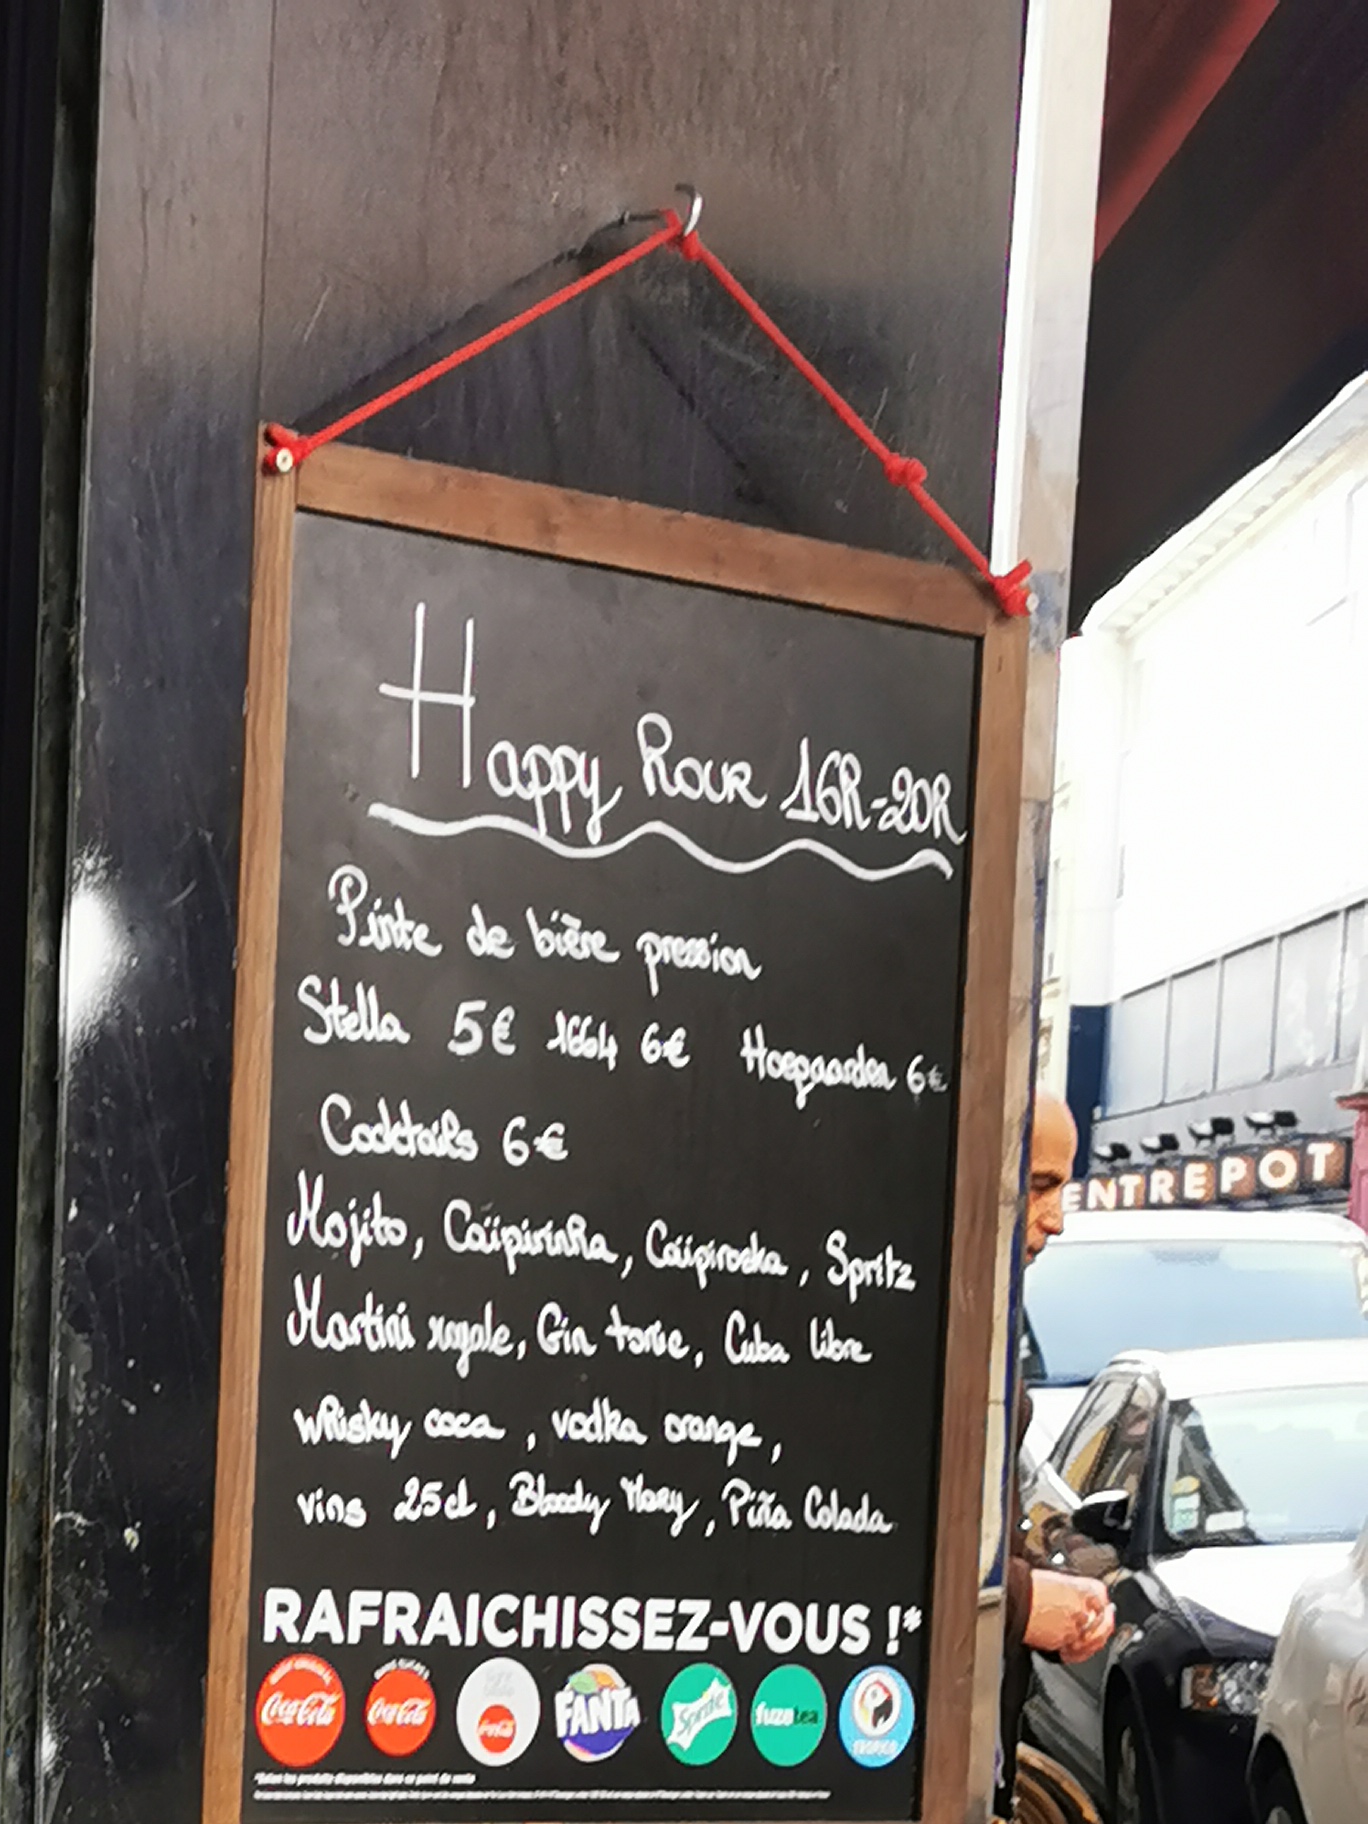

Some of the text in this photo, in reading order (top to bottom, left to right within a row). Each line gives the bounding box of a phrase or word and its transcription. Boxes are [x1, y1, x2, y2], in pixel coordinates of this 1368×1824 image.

[378, 602, 622, 845] Happy
[328, 864, 763, 998] Pinte de bière pression
[297, 974, 411, 1045] Stella
[546, 1009, 618, 1072] 1664
[640, 1022, 690, 1069] 6€
[1063, 1142, 1335, 1212] ENTREPOT
[825, 1229, 917, 1304] Spritz
[286, 1273, 416, 1352] Martini
[536, 1301, 598, 1357] Gin
[724, 1309, 791, 1366] Cuba
[551, 1396, 648, 1444] vodka
[296, 1486, 368, 1528] vins
[508, 1470, 611, 1536] Bloody
[721, 1478, 793, 1530] Piña
[803, 1485, 895, 1534] Colada
[263, 1586, 871, 1656] RAFRAICHISSEZ-VOUS
[554, 1685, 641, 1738] FANTA
